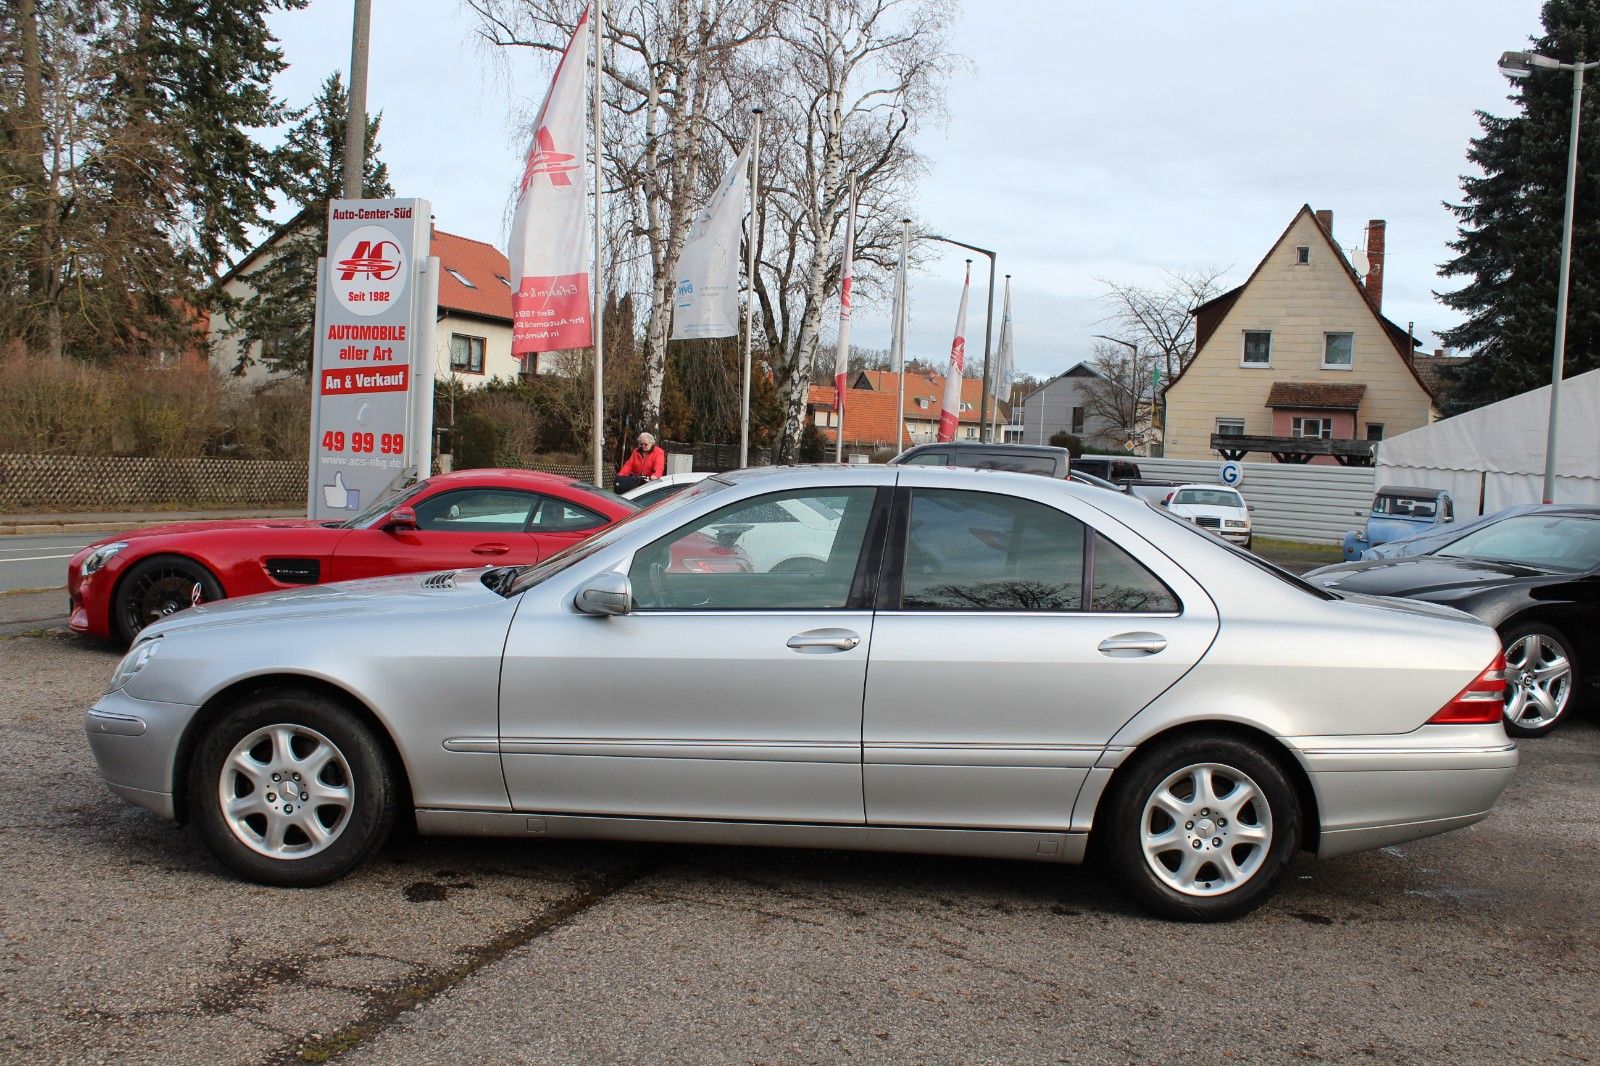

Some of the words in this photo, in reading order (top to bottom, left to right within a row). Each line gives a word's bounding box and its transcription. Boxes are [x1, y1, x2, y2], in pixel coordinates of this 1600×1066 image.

[333, 208, 412, 220] Auto-Center-Süd
[348, 292, 365, 301] Seit
[369, 292, 390, 301] 1982
[328, 325, 406, 341] AUTOMOBILE
[340, 345, 369, 360] aller
[373, 346, 393, 361] Art
[326, 375, 341, 389] An
[344, 375, 352, 388] &
[355, 371, 404, 387] Verkauf
[322, 431, 345, 452] 49
[351, 432, 374, 453] 99
[381, 433, 404, 454] 99
[321, 456, 402, 469] www.acs-nbg.de
[1222, 465, 1238, 483] G
